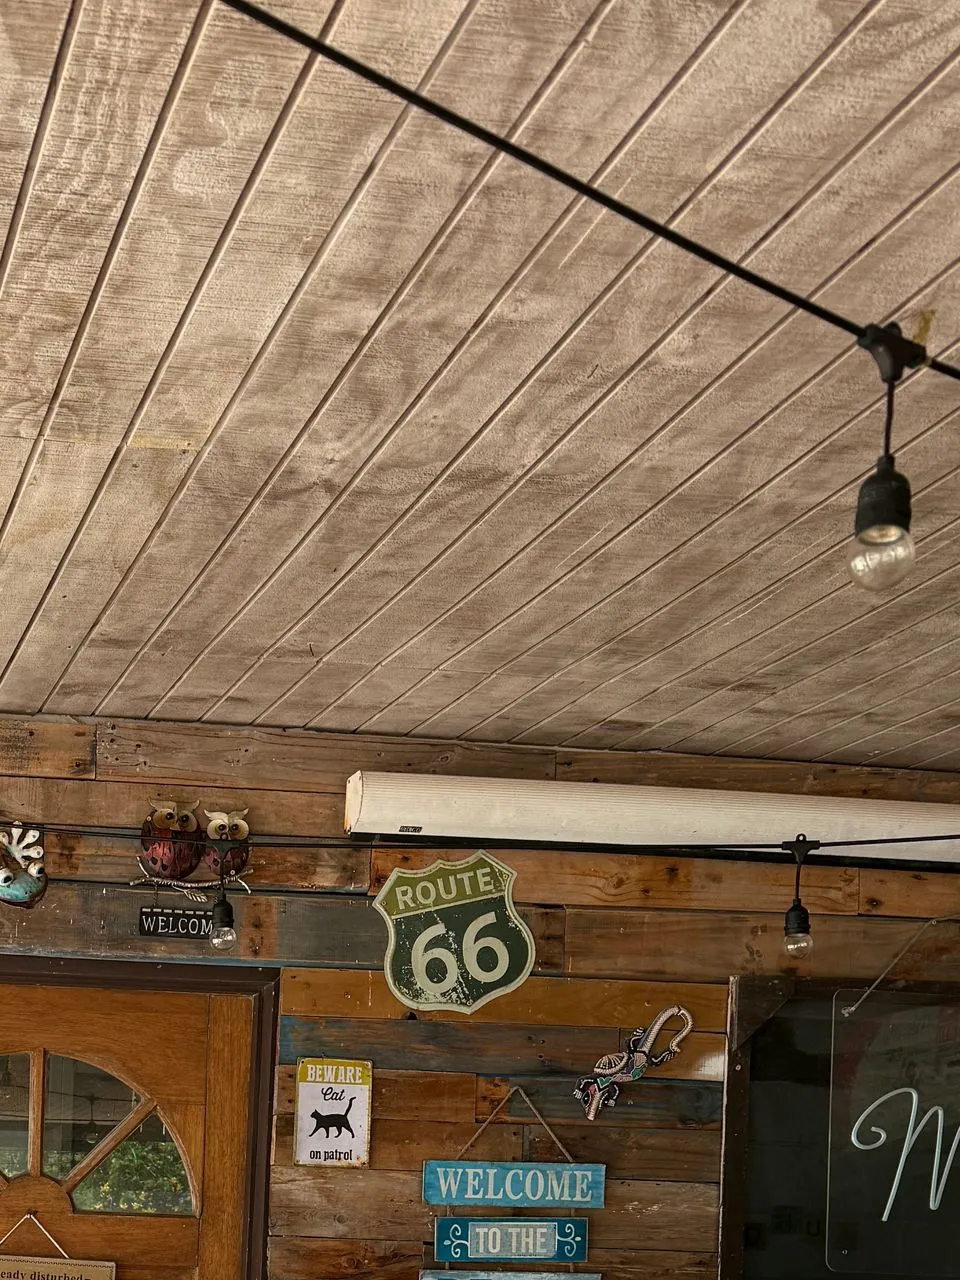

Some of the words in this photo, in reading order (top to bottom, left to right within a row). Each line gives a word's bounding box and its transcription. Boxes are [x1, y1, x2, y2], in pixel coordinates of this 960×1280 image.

[395, 868, 494, 910] ROUTE
[141, 915, 213, 935] WELCOM
[411, 911, 510, 995] 66
[306, 1064, 363, 1083] BEWARE
[321, 1086, 345, 1102] Cat
[309, 1150, 321, 1160] on
[323, 1149, 353, 1162] patrol
[436, 1167, 593, 1202] WELCOME
[475, 1227, 501, 1254] TO
[508, 1227, 548, 1254] THE
